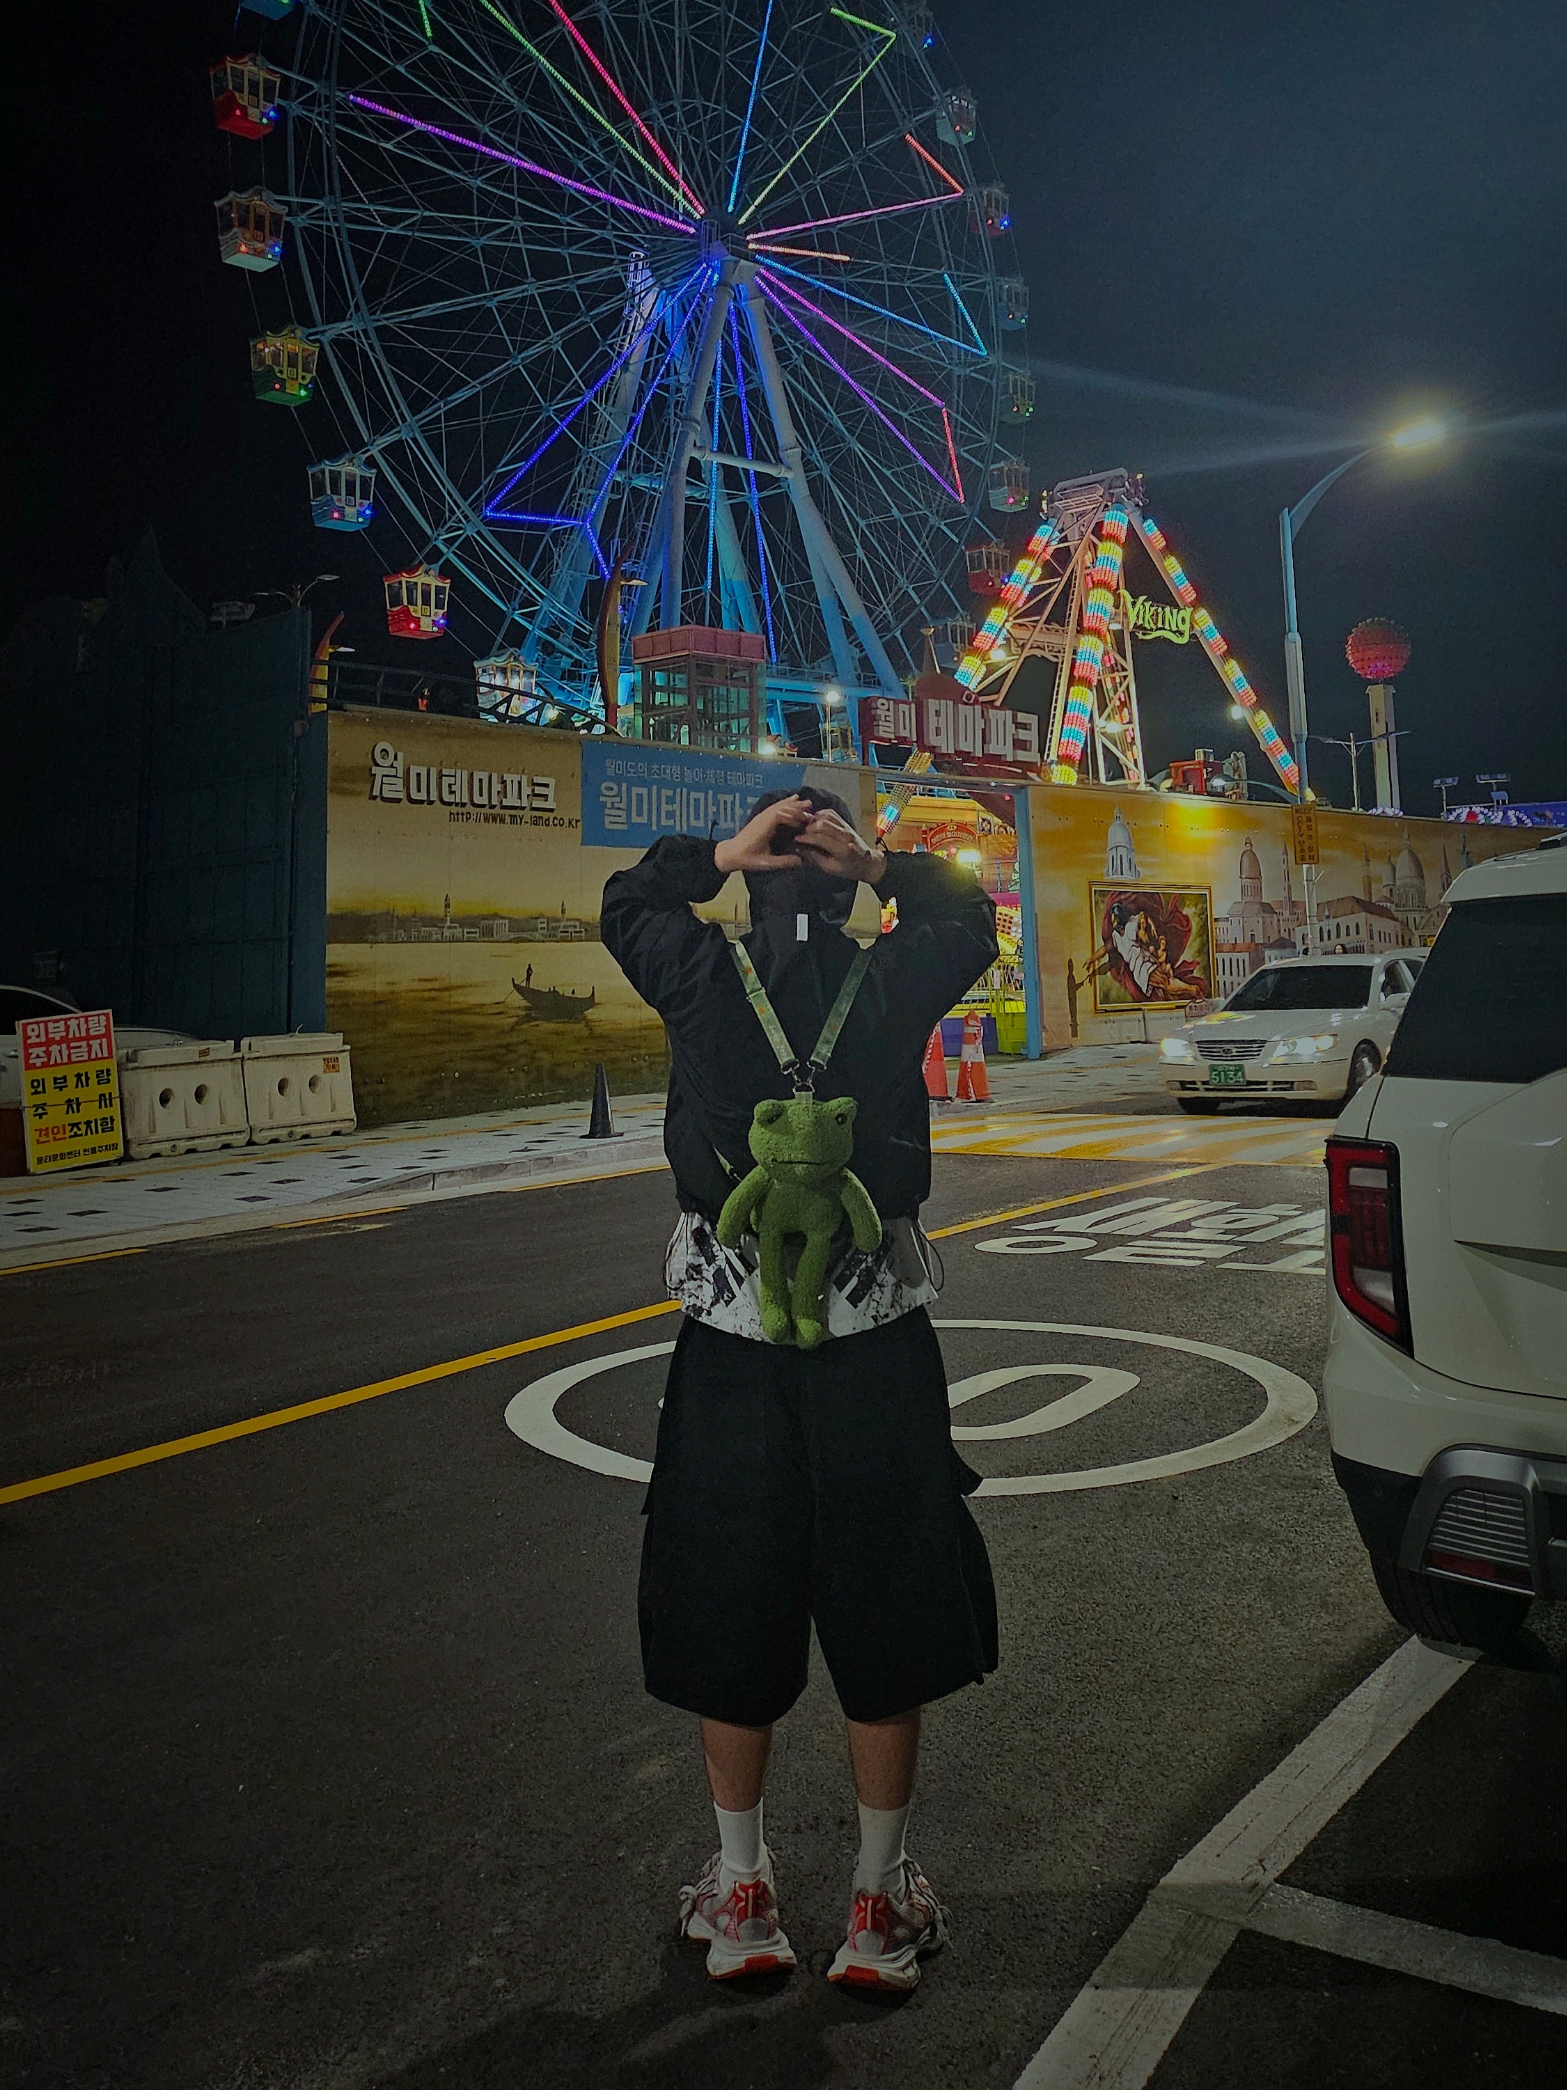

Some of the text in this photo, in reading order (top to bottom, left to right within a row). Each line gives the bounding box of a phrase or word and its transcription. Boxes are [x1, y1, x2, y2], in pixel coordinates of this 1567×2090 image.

[875, 697, 1041, 763] 월미 테마파크
[369, 740, 557, 813] 월미테마파크
[605, 758, 648, 780] 월미도의
[650, 761, 682, 781] 초대형
[726, 770, 765, 790] 테마파크
[26, 1011, 107, 1045] 외부차량
[28, 1037, 109, 1068] 주차금지
[1211, 1071, 1244, 1083] 5134
